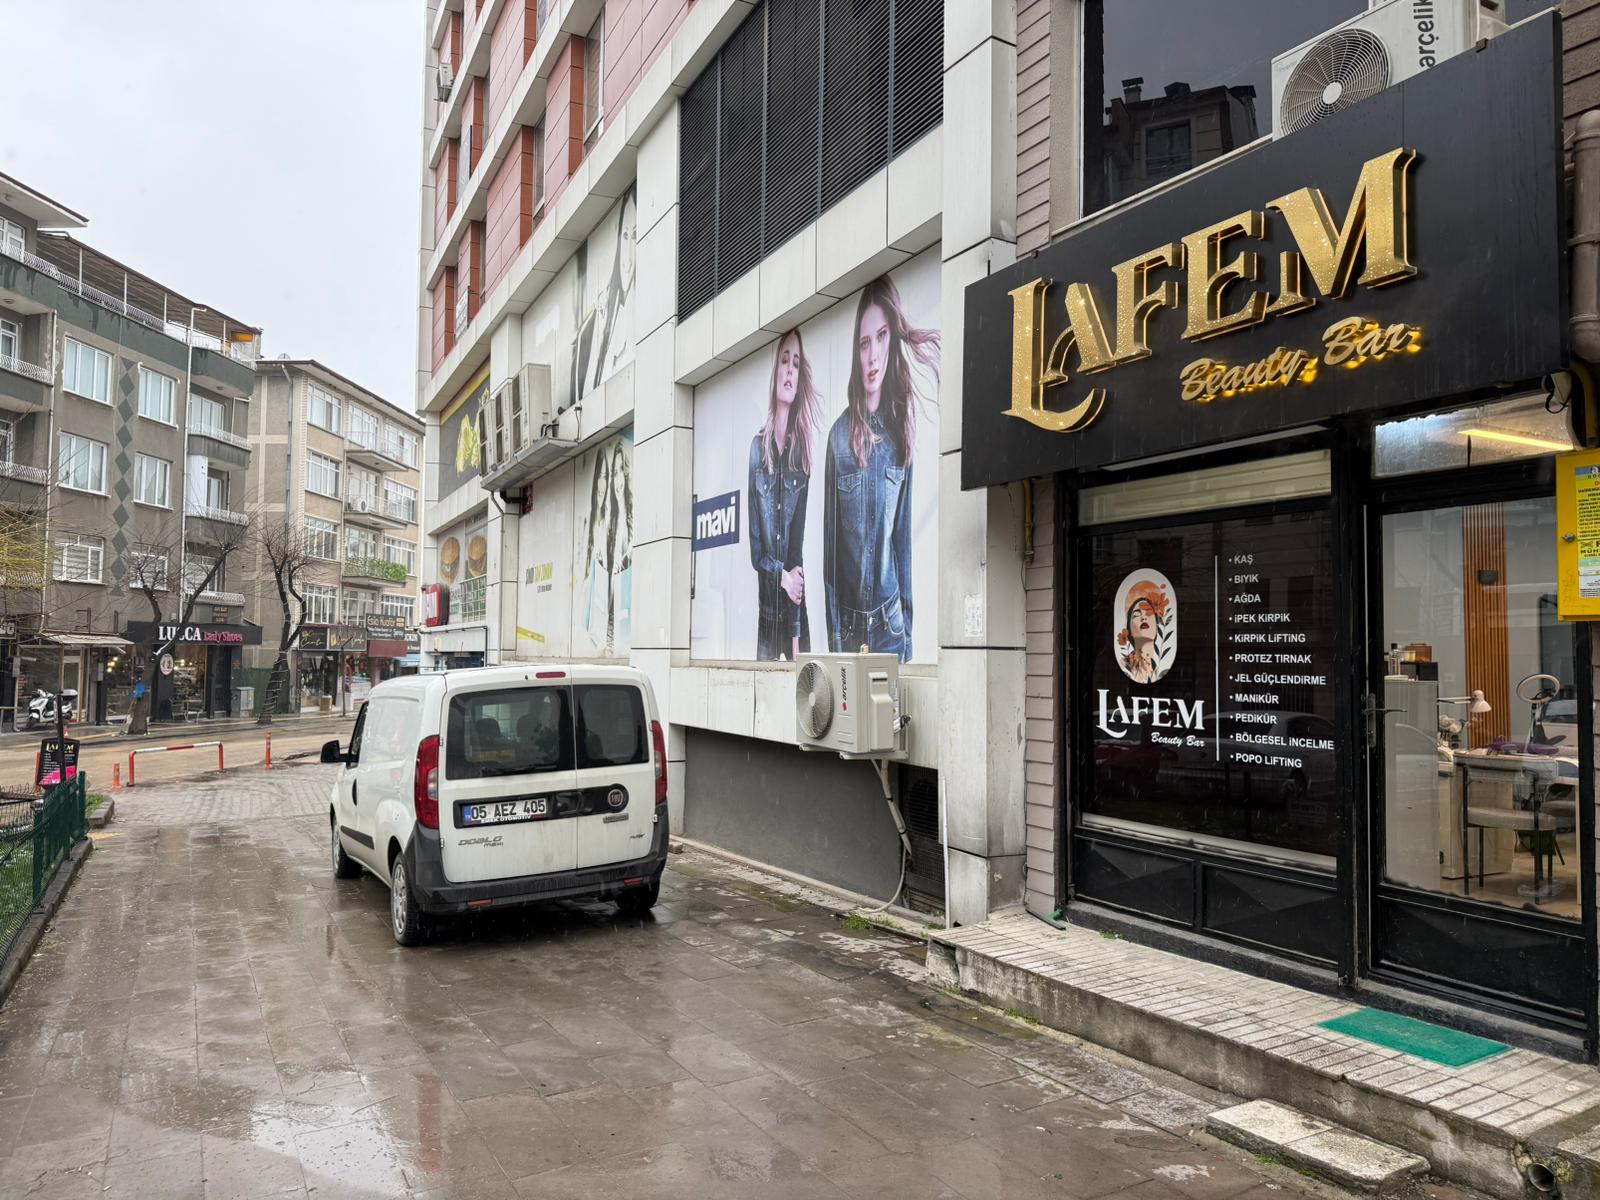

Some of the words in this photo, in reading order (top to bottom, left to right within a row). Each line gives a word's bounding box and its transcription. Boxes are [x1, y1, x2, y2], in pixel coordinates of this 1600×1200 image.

[1000, 146, 1418, 432] LAFEM
[1180, 345, 1314, 402] Beauty
[1323, 316, 1421, 368] Bar
[696, 497, 736, 539] mavi
[1234, 555, 1254, 565] KAŞ
[1234, 574, 1259, 584] BIYIK
[1234, 592, 1261, 604] AĞDA
[1234, 653, 1272, 664] PROTEZ
[1274, 654, 1312, 664] TIRNAK
[1235, 673, 1251, 683] JEL
[1096, 689, 1205, 738] LAFEM
[1151, 732, 1183, 747] Beauty
[1186, 735, 1205, 747] Bar
[1235, 732, 1287, 746] BÖLGESEL
[1235, 752, 1262, 764] POPO
[471, 806, 486, 820] 05
[494, 803, 517, 818] AEZ
[523, 800, 546, 814] 405
